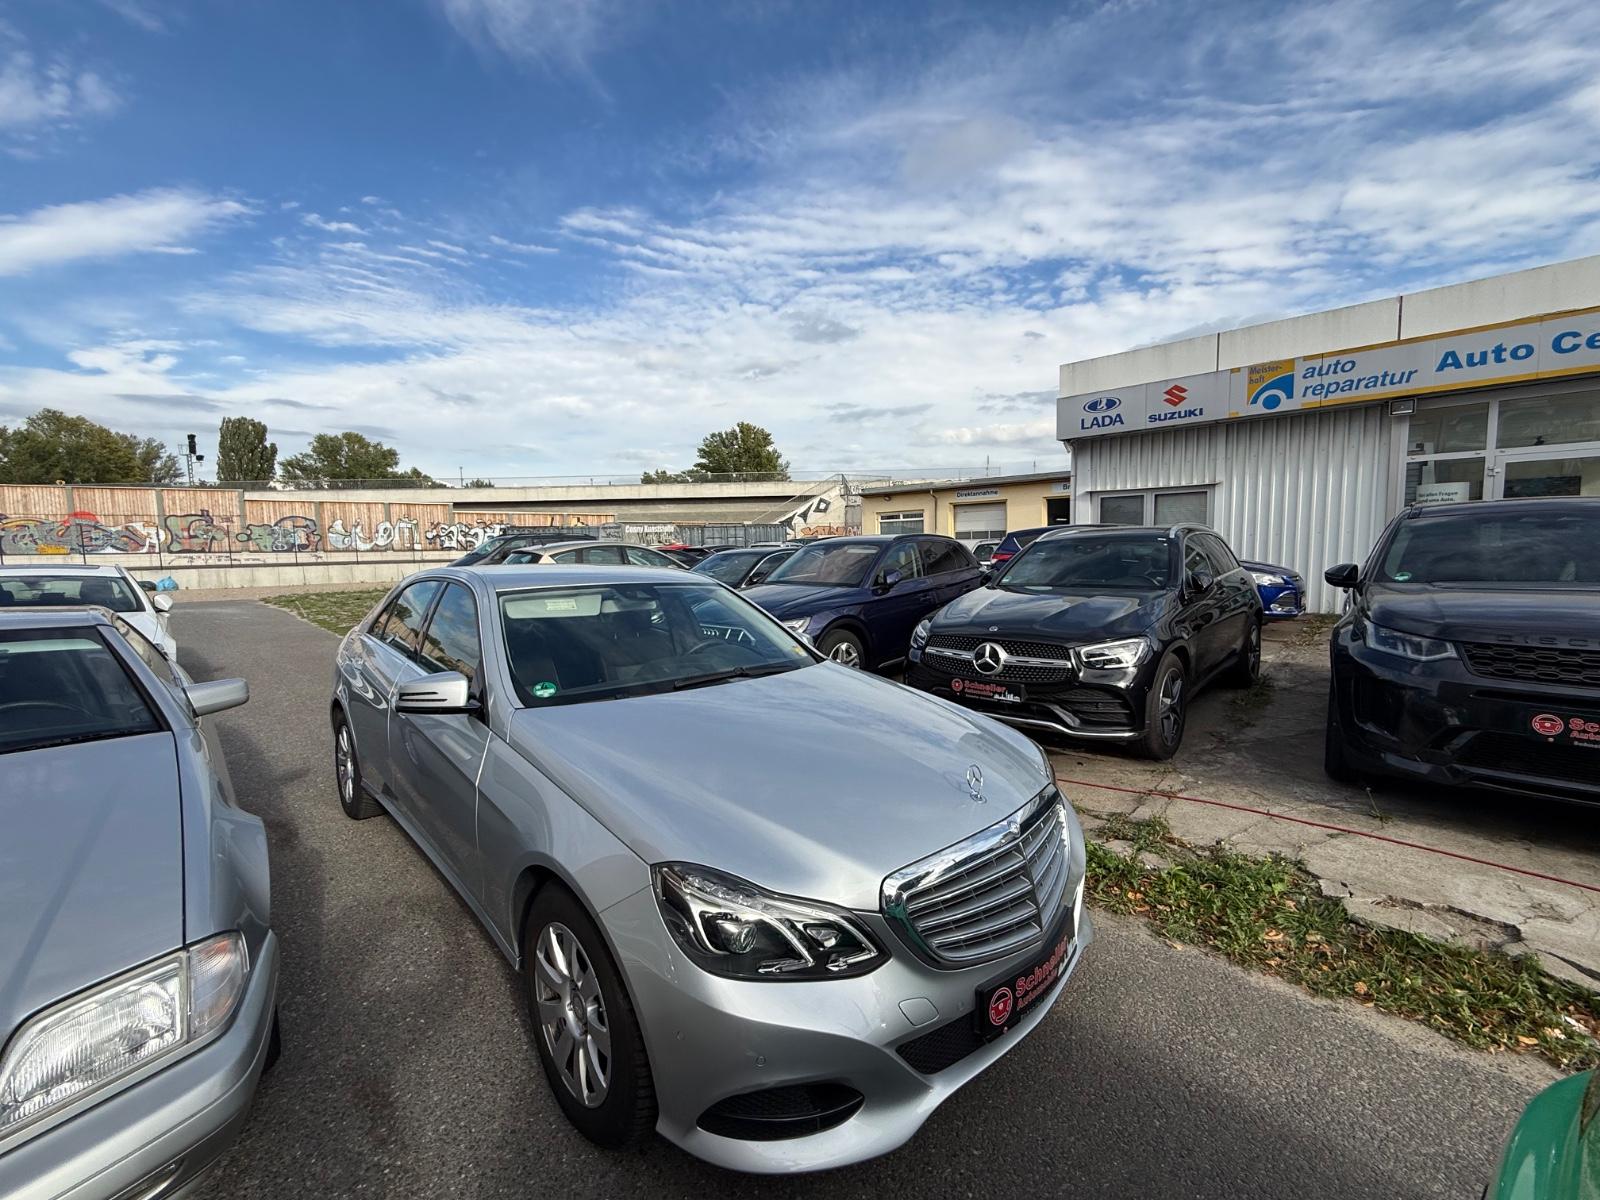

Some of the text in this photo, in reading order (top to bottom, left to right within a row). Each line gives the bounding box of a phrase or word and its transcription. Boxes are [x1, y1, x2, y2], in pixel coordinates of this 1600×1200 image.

[1435, 343, 1535, 372] Auto
[1302, 360, 1346, 380] auto
[1302, 369, 1418, 399] reparatur
[1080, 413, 1124, 430] LADA
[1148, 408, 1203, 422] SUZUKI
[956, 490, 998, 498] Direktannahme
[1497, 634, 1600, 647] DISC
[1569, 717, 1600, 732] Sc
